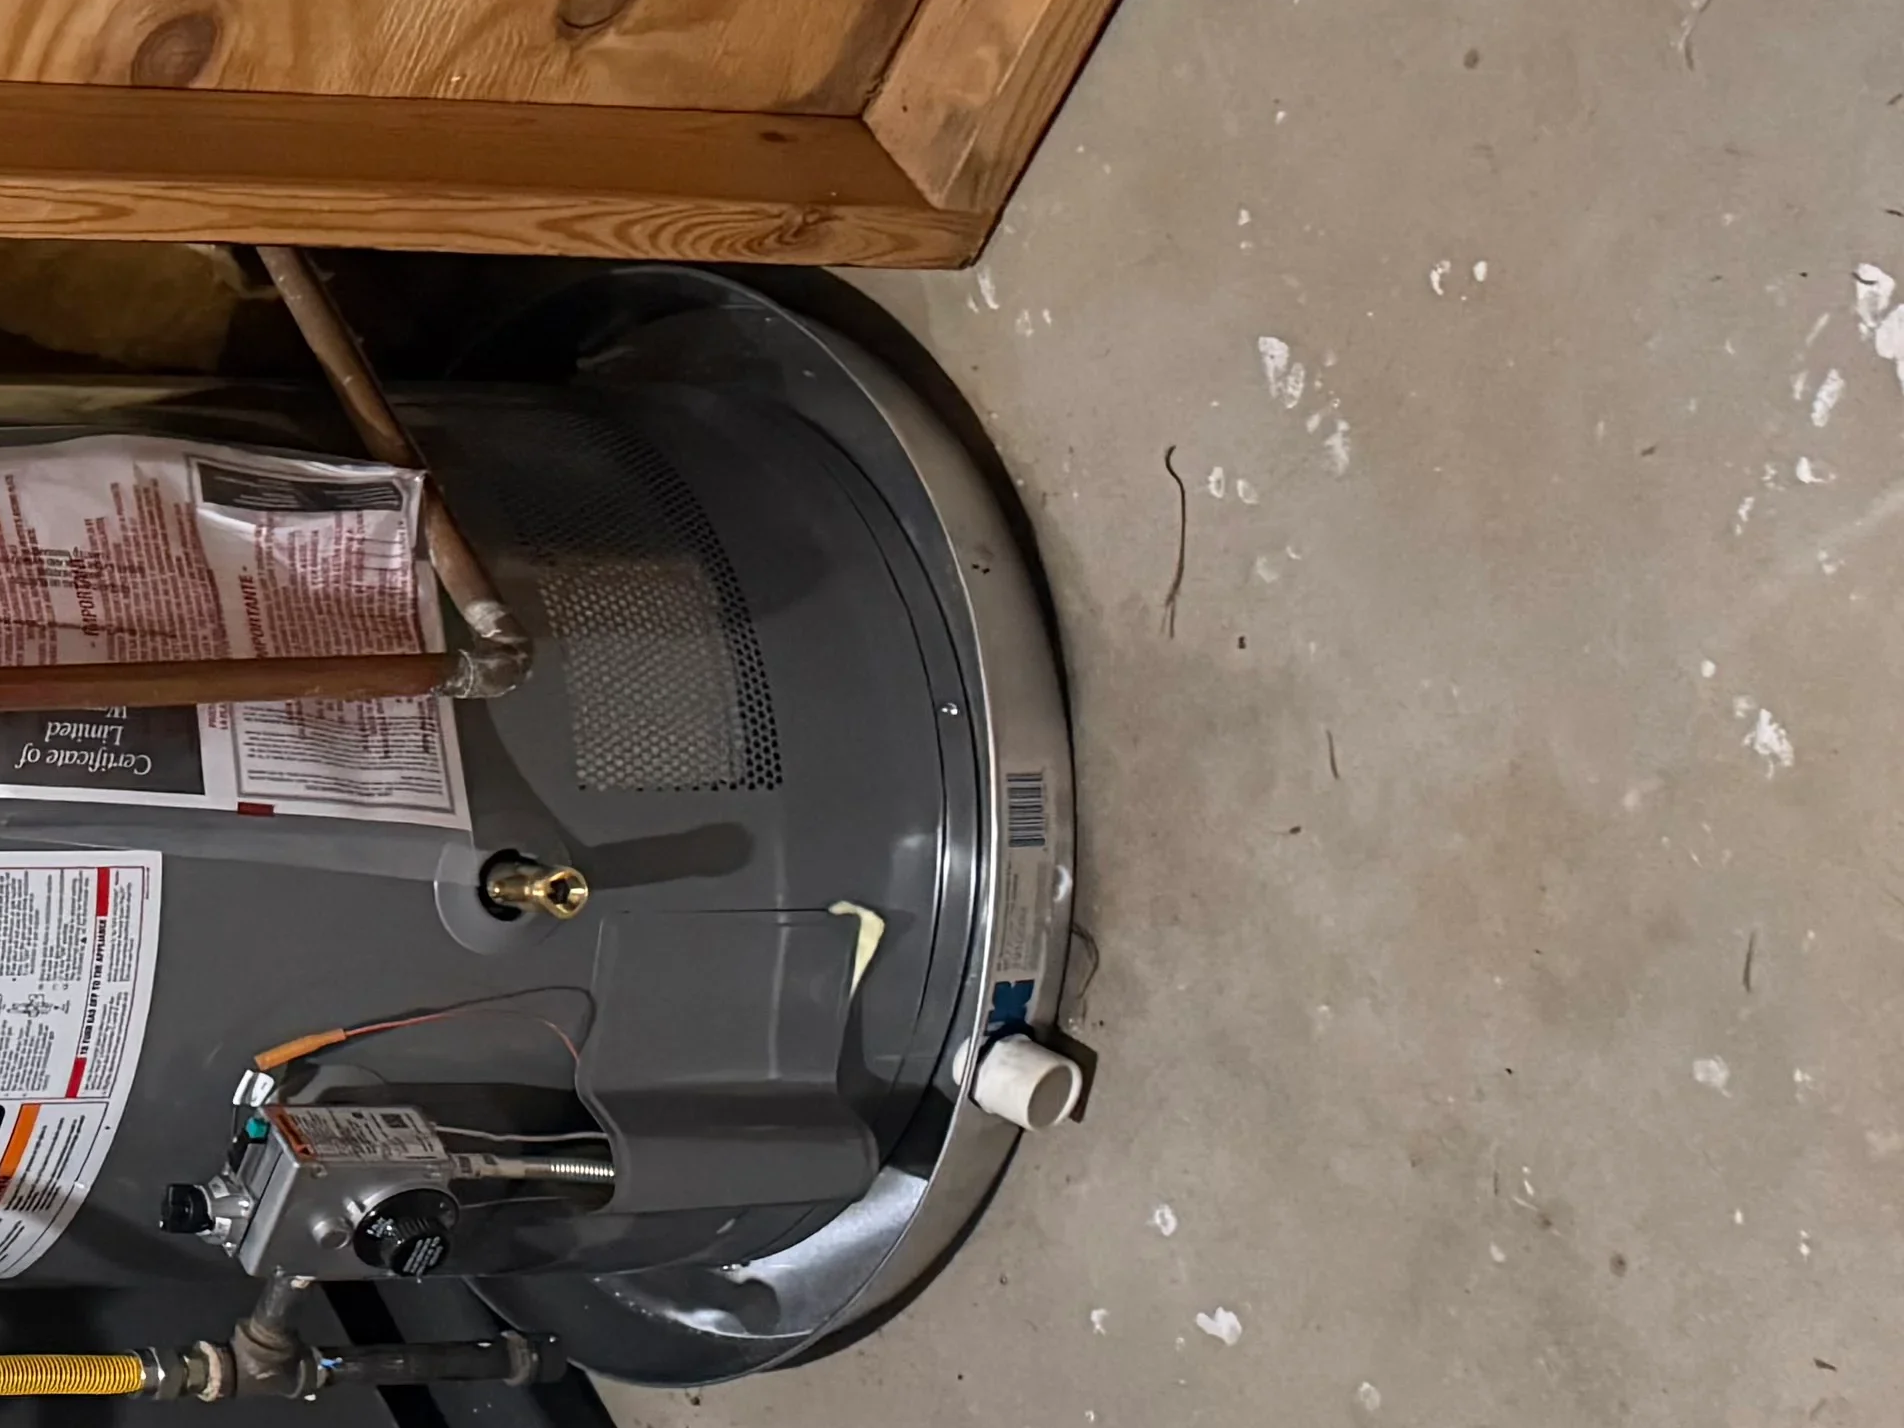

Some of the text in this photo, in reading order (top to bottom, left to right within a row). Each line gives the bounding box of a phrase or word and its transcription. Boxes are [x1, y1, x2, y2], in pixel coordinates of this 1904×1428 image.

[238, 575, 269, 658] MPORTANTE
[45, 721, 124, 746] Limited
[14, 742, 153, 775] Certificate of
